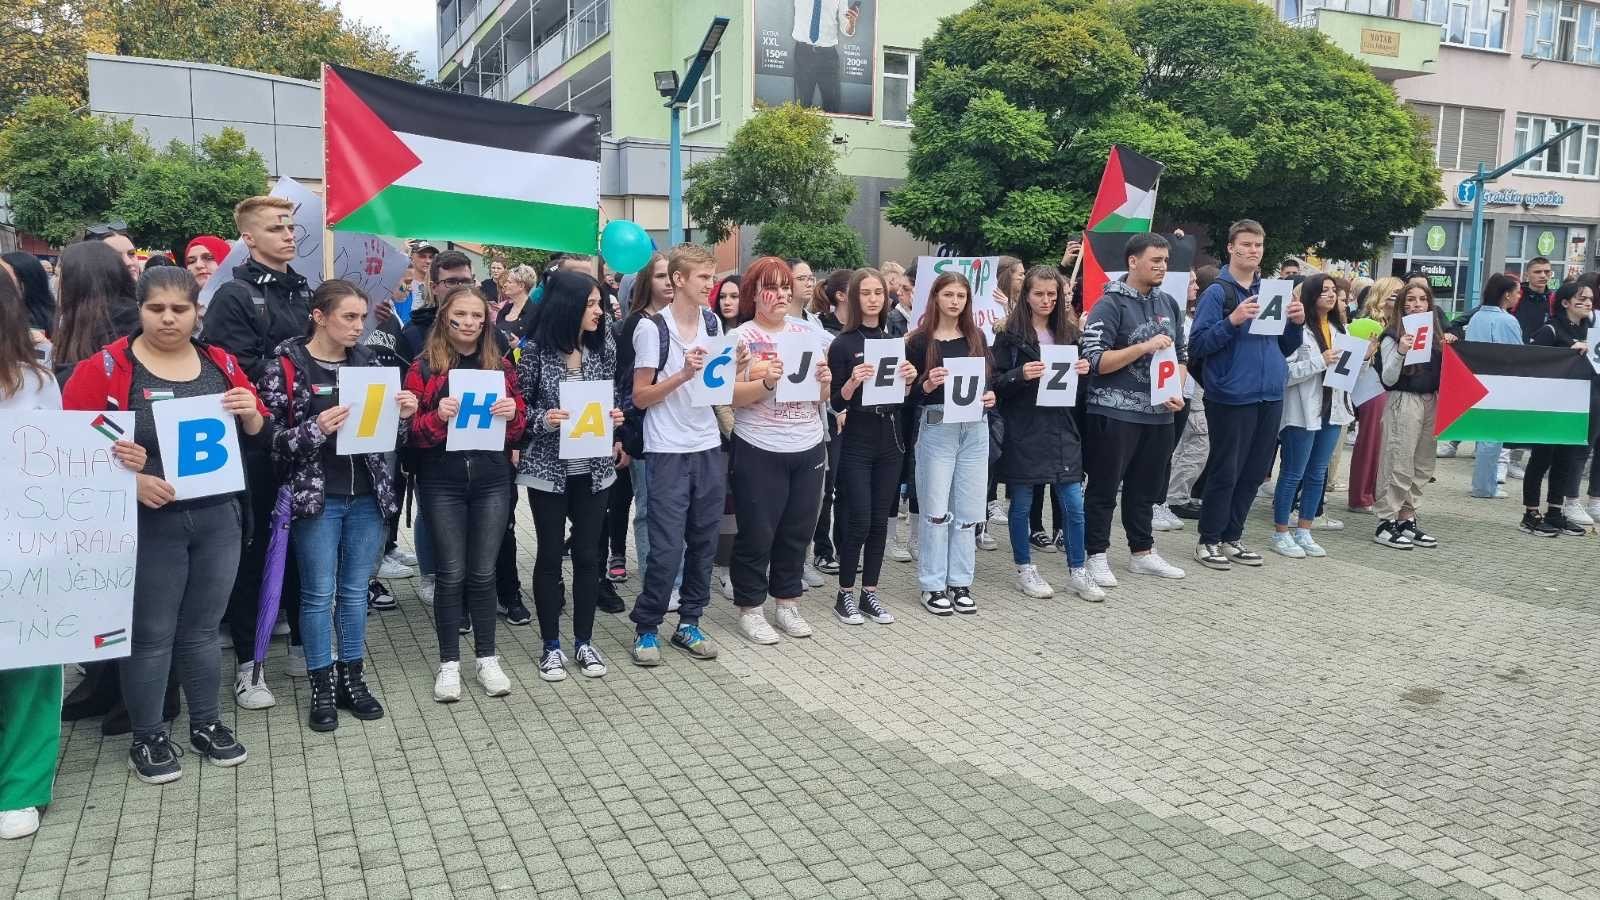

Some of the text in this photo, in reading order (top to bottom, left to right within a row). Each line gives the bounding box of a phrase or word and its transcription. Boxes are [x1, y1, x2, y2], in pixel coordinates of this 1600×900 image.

[763, 37, 780, 46] XXL
[1421, 265, 1446, 275] Gradska
[1429, 275, 1452, 287] TEKA
[1259, 295, 1282, 320] A
[1413, 327, 1428, 350] E
[703, 347, 732, 389] Ć
[787, 351, 813, 383] J
[875, 356, 898, 387] E
[1046, 362, 1070, 390] Z
[1157, 360, 1175, 389] P
[1334, 351, 1352, 376] L
[952, 375, 979, 406] U
[356, 383, 386, 438] I
[455, 392, 498, 429] H
[567, 401, 606, 439] A
[177, 417, 229, 478] B
